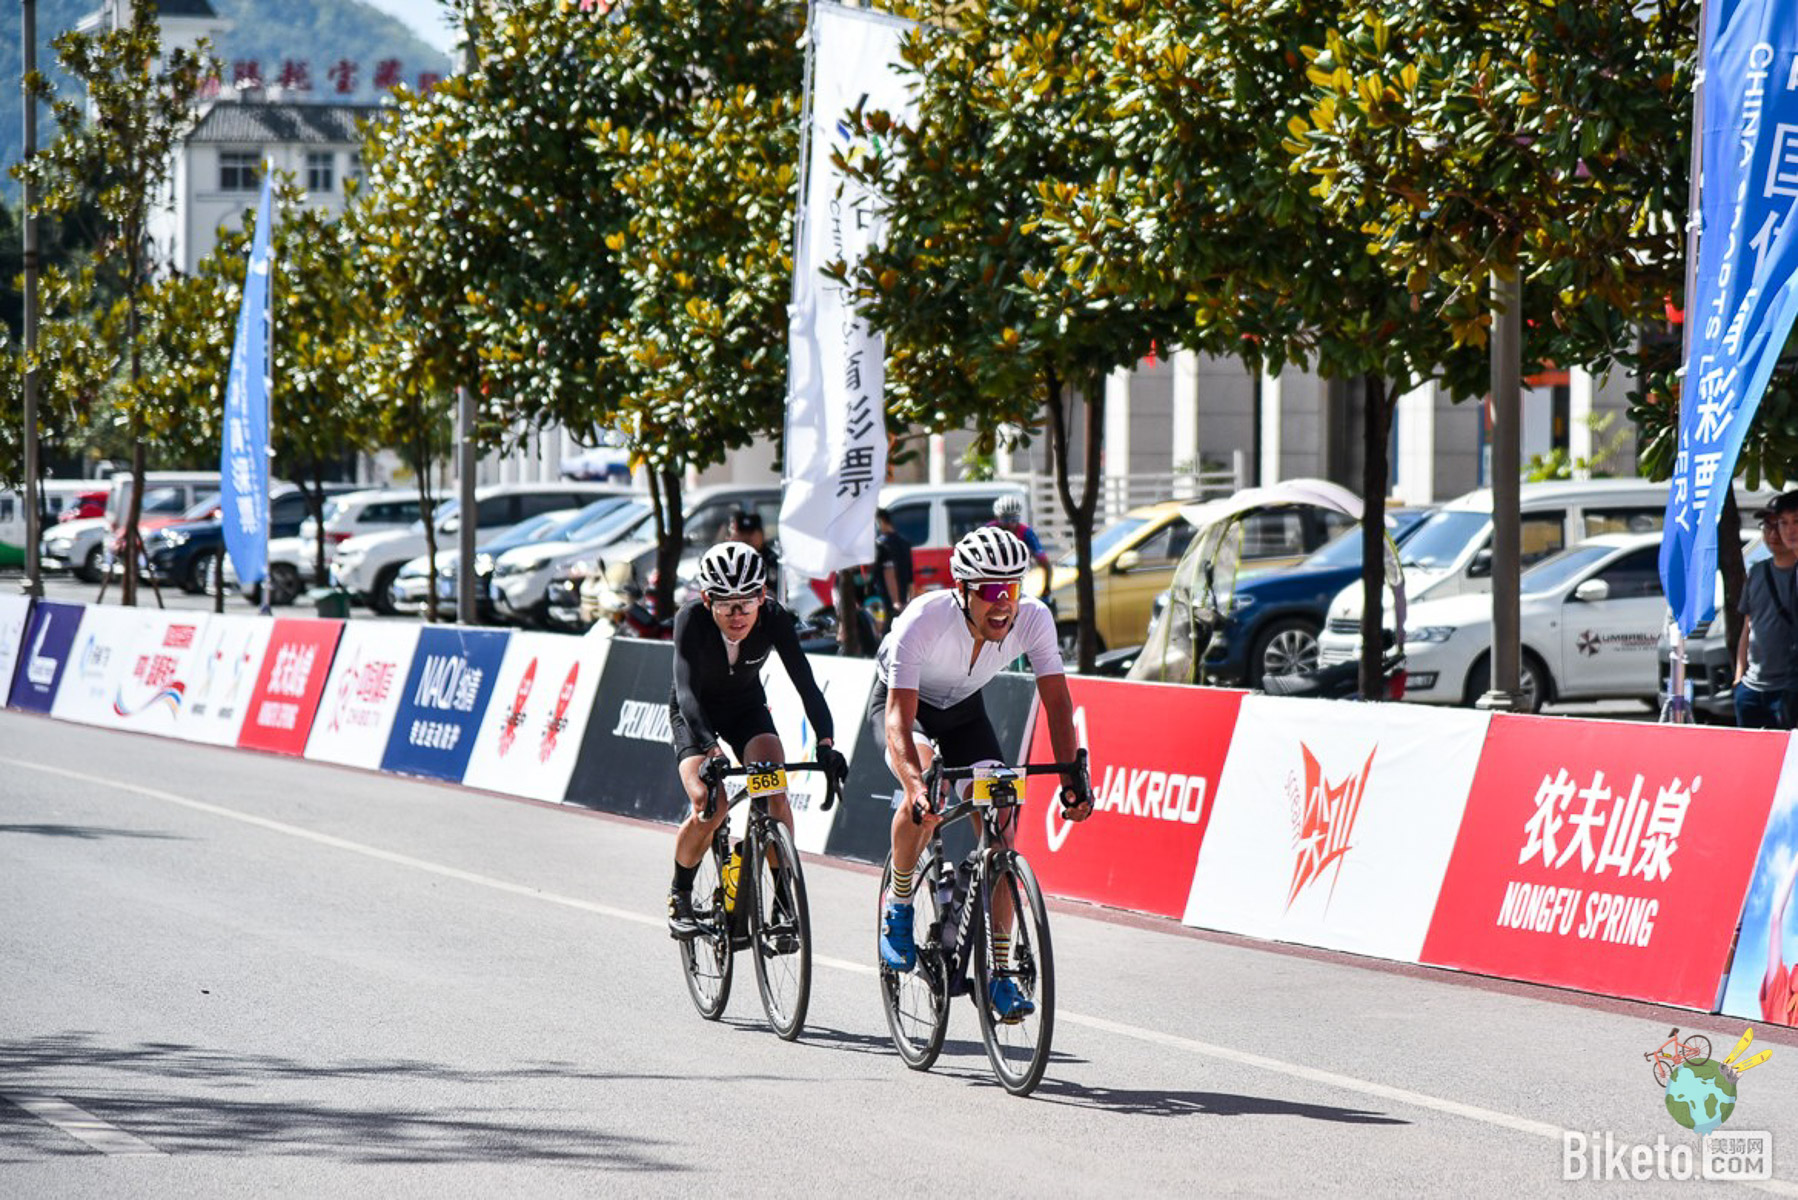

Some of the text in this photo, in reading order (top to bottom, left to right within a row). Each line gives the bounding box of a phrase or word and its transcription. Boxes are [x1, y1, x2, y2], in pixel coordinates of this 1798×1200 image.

[1739, 42, 1774, 168] CHINA
[829, 199, 844, 262] CHIN
[752, 772, 780, 790] 568
[1092, 764, 1208, 824] JAKROO
[1518, 767, 1691, 882] 农夫山泉
[1496, 881, 1660, 947] NONGFU SPRING
